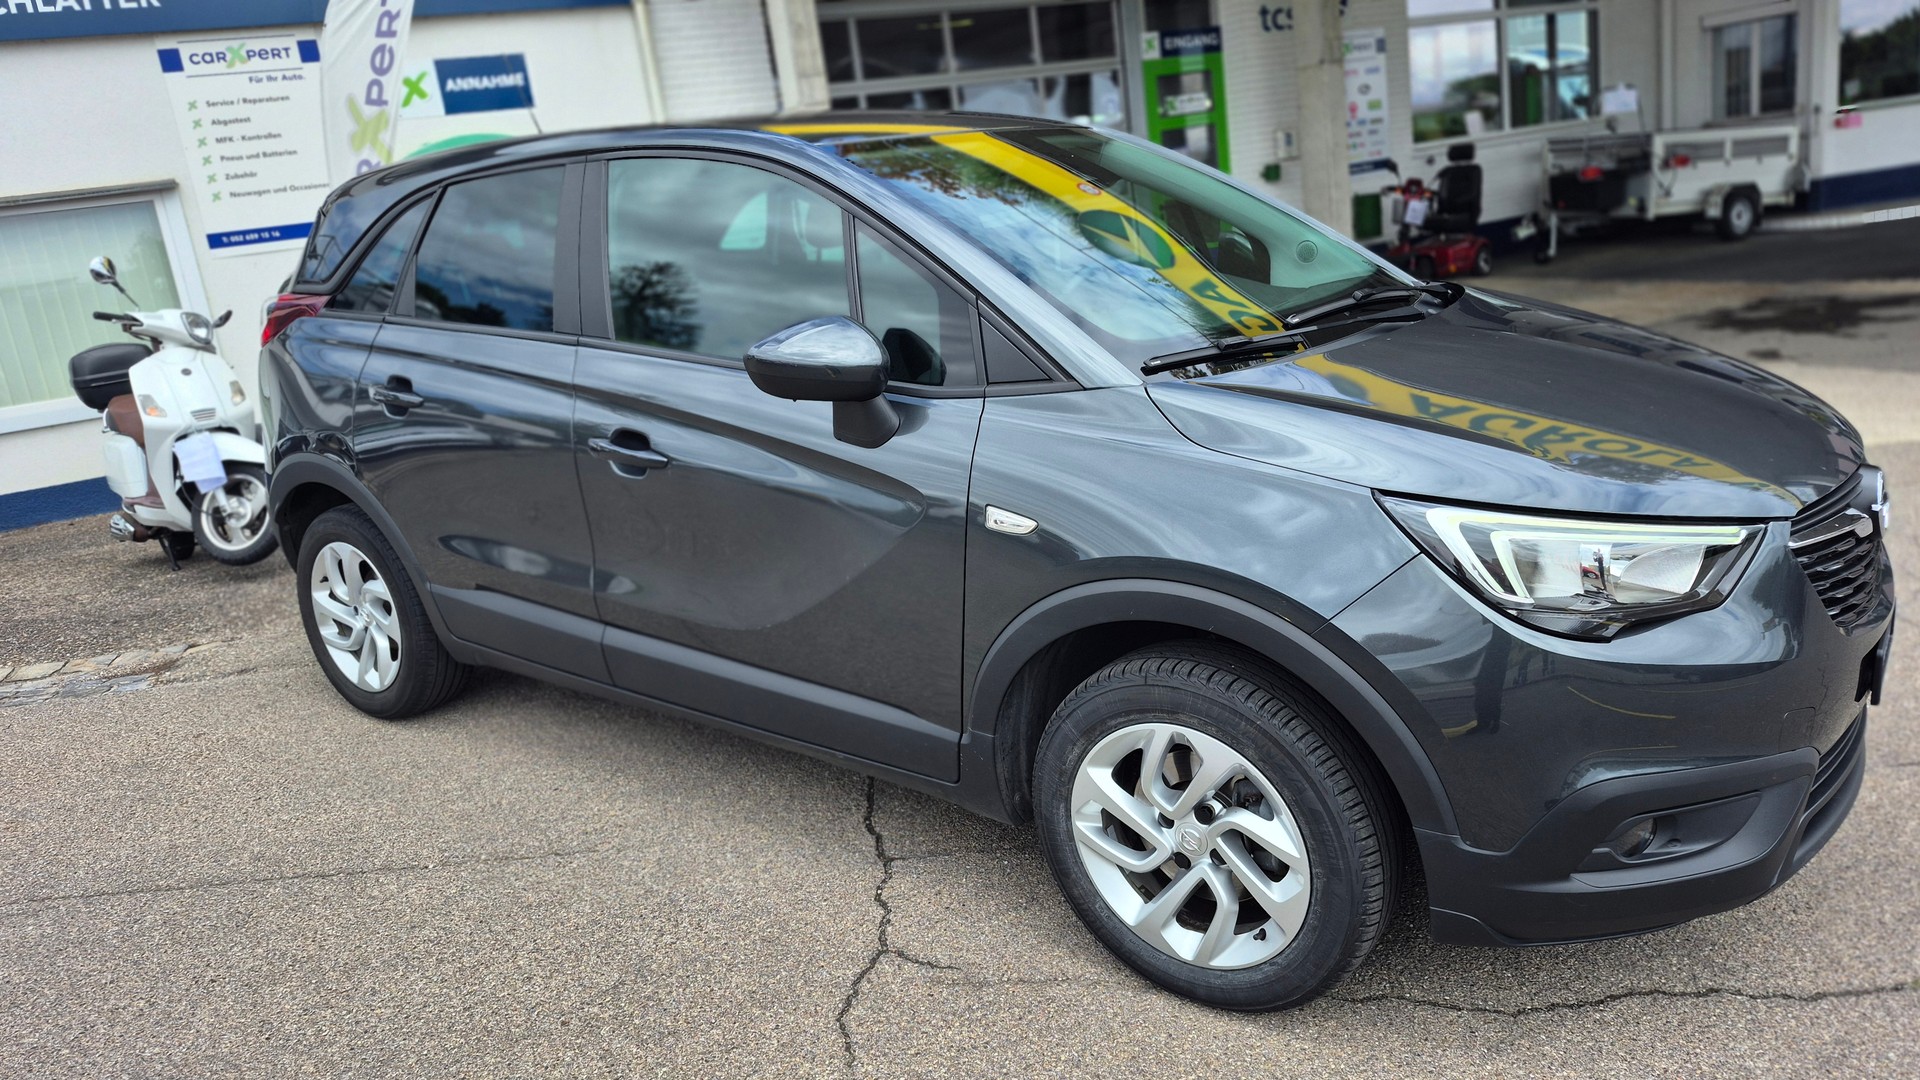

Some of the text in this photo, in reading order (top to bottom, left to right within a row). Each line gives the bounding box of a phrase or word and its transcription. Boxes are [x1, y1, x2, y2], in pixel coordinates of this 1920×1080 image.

[1163, 33, 1219, 49] EINGANG
[248, 72, 306, 84] Für Ihr Auto.
[445, 72, 525, 92] ANNAHME
[206, 99, 236, 108] Service
[242, 94, 290, 105] Reparaturen
[211, 116, 251, 128] Abgastest
[215, 136, 234, 145] MFK
[241, 131, 282, 142] Kontrollen
[220, 148, 298, 163] Pneus und Batterien
[225, 170, 258, 181] Zubehör
[229, 187, 271, 200] Neuwagen
[273, 185, 287, 194] und
